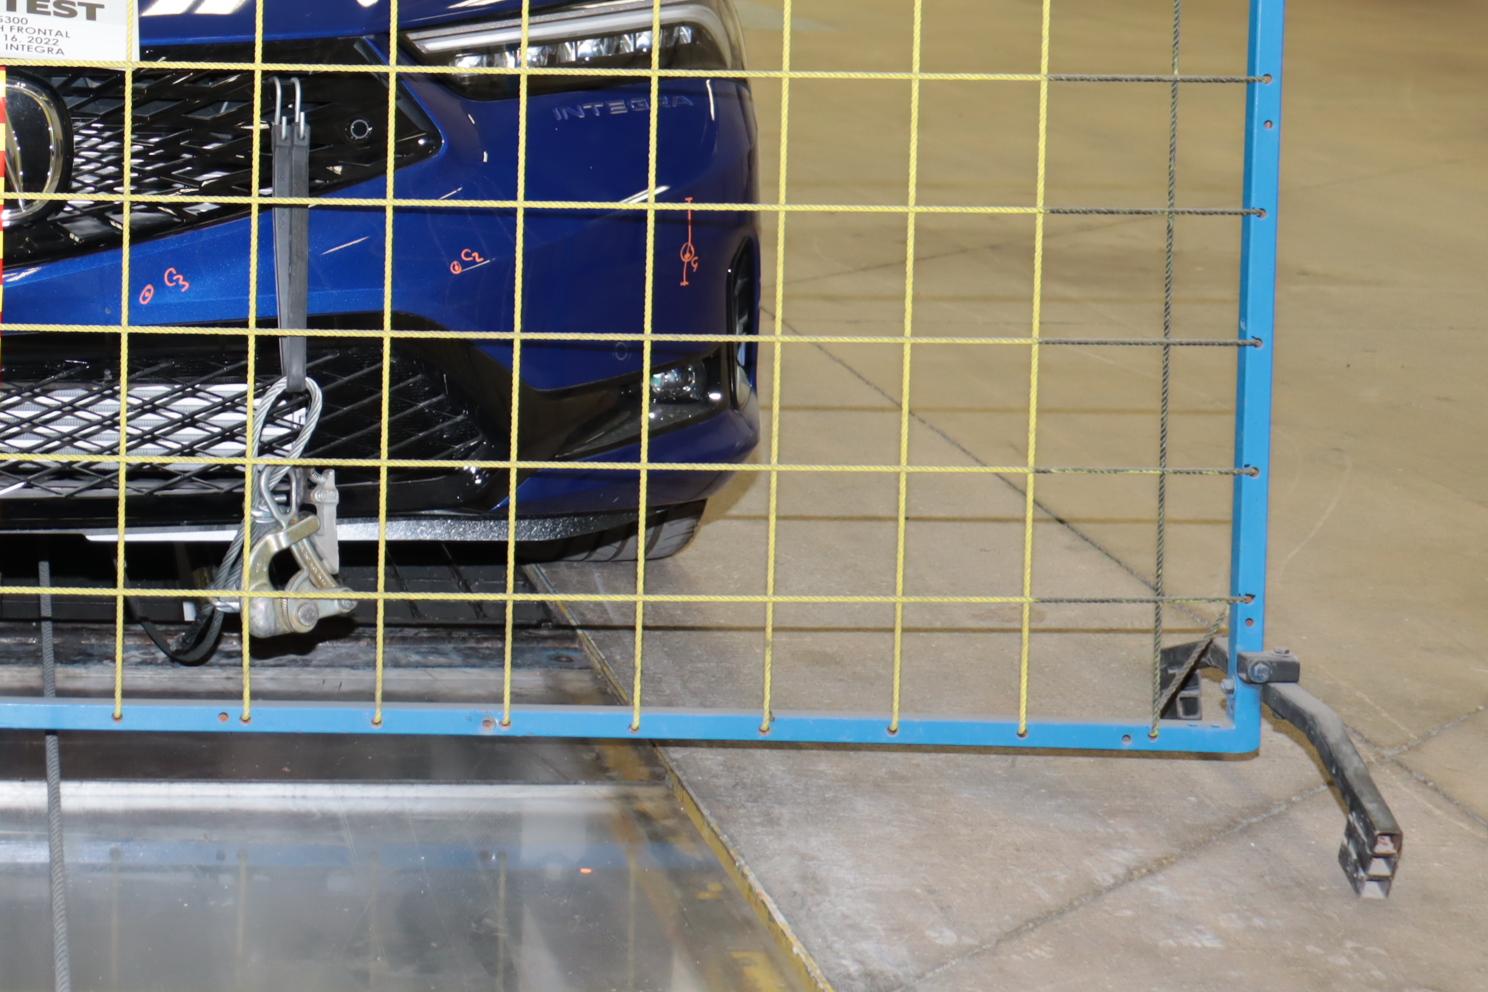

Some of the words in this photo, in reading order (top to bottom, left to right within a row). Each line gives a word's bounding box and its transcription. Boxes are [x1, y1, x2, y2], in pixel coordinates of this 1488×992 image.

[10, 25, 71, 38] FRONTAL
[27, 36, 59, 47] 2022
[5, 43, 65, 56] INTEGRA
[552, 95, 694, 121] INTEGRA
